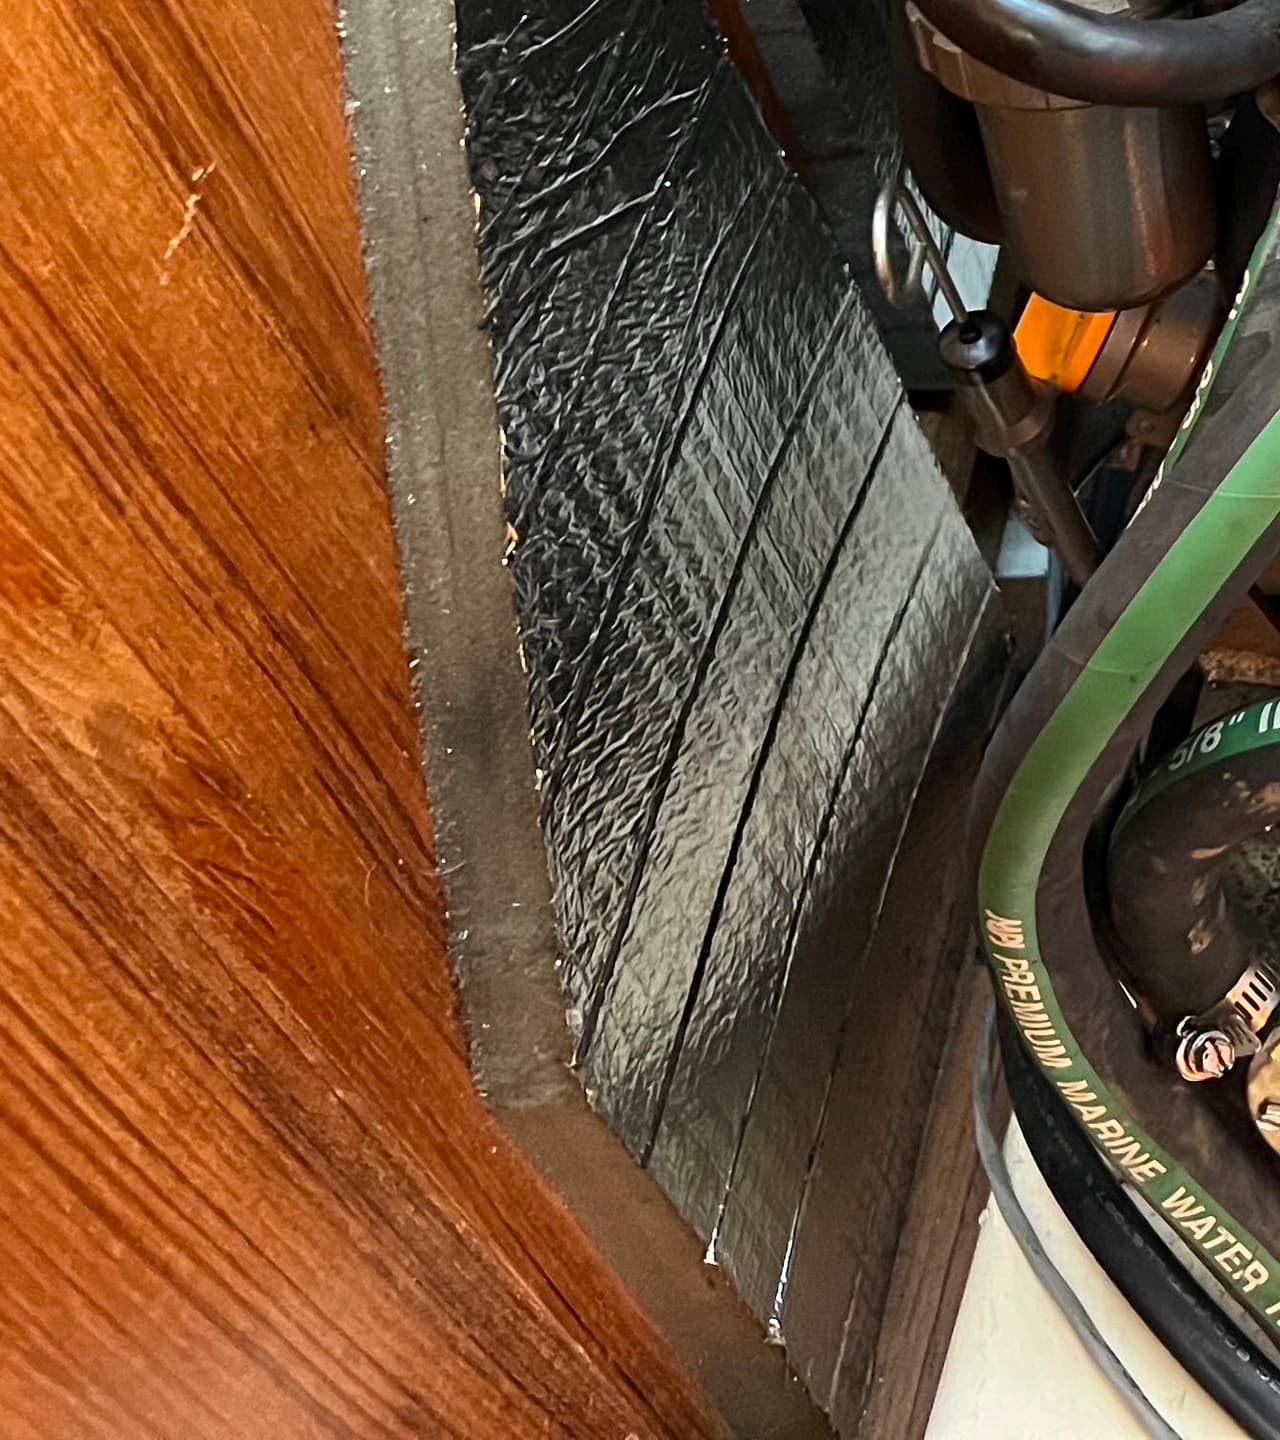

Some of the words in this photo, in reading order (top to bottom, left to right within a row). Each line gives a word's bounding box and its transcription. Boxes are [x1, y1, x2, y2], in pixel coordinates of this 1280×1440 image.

[992, 952, 1072, 1069] PREMIUM
[1057, 1079, 1168, 1183] MARINE
[1161, 1186, 1271, 1294] WATER
